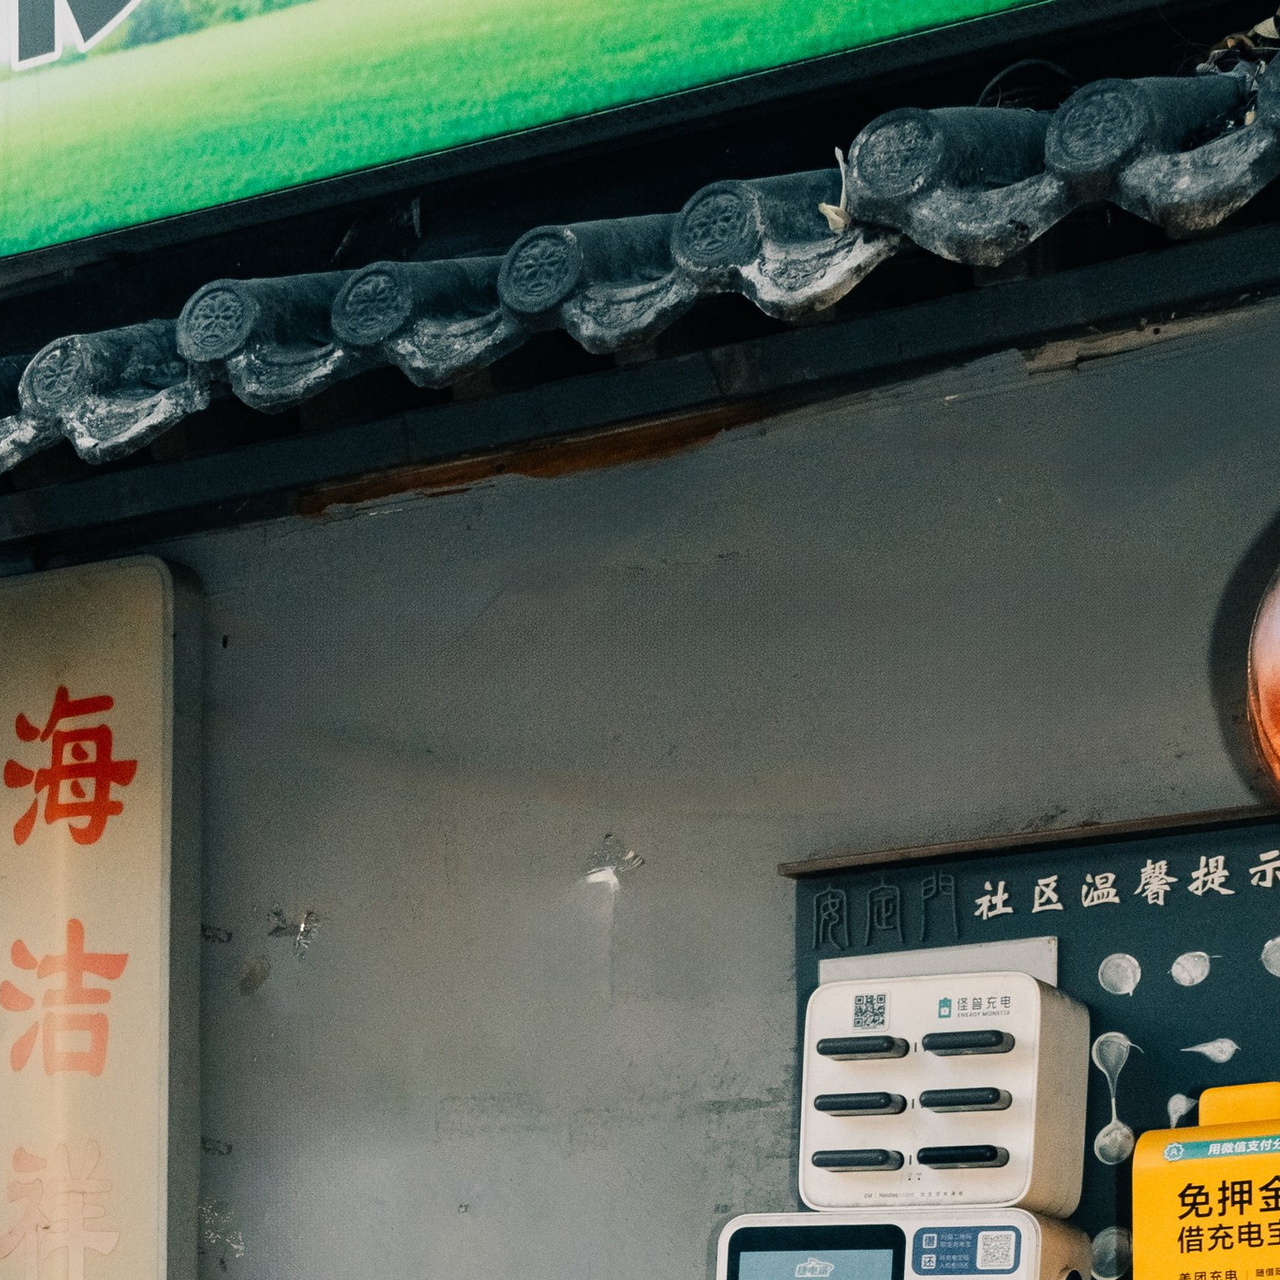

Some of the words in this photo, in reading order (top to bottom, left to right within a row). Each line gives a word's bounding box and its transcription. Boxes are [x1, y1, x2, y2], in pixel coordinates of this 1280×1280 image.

[973, 850, 1280, 920] 社区温馨提示
[957, 996, 1011, 1011] 怪兽充电
